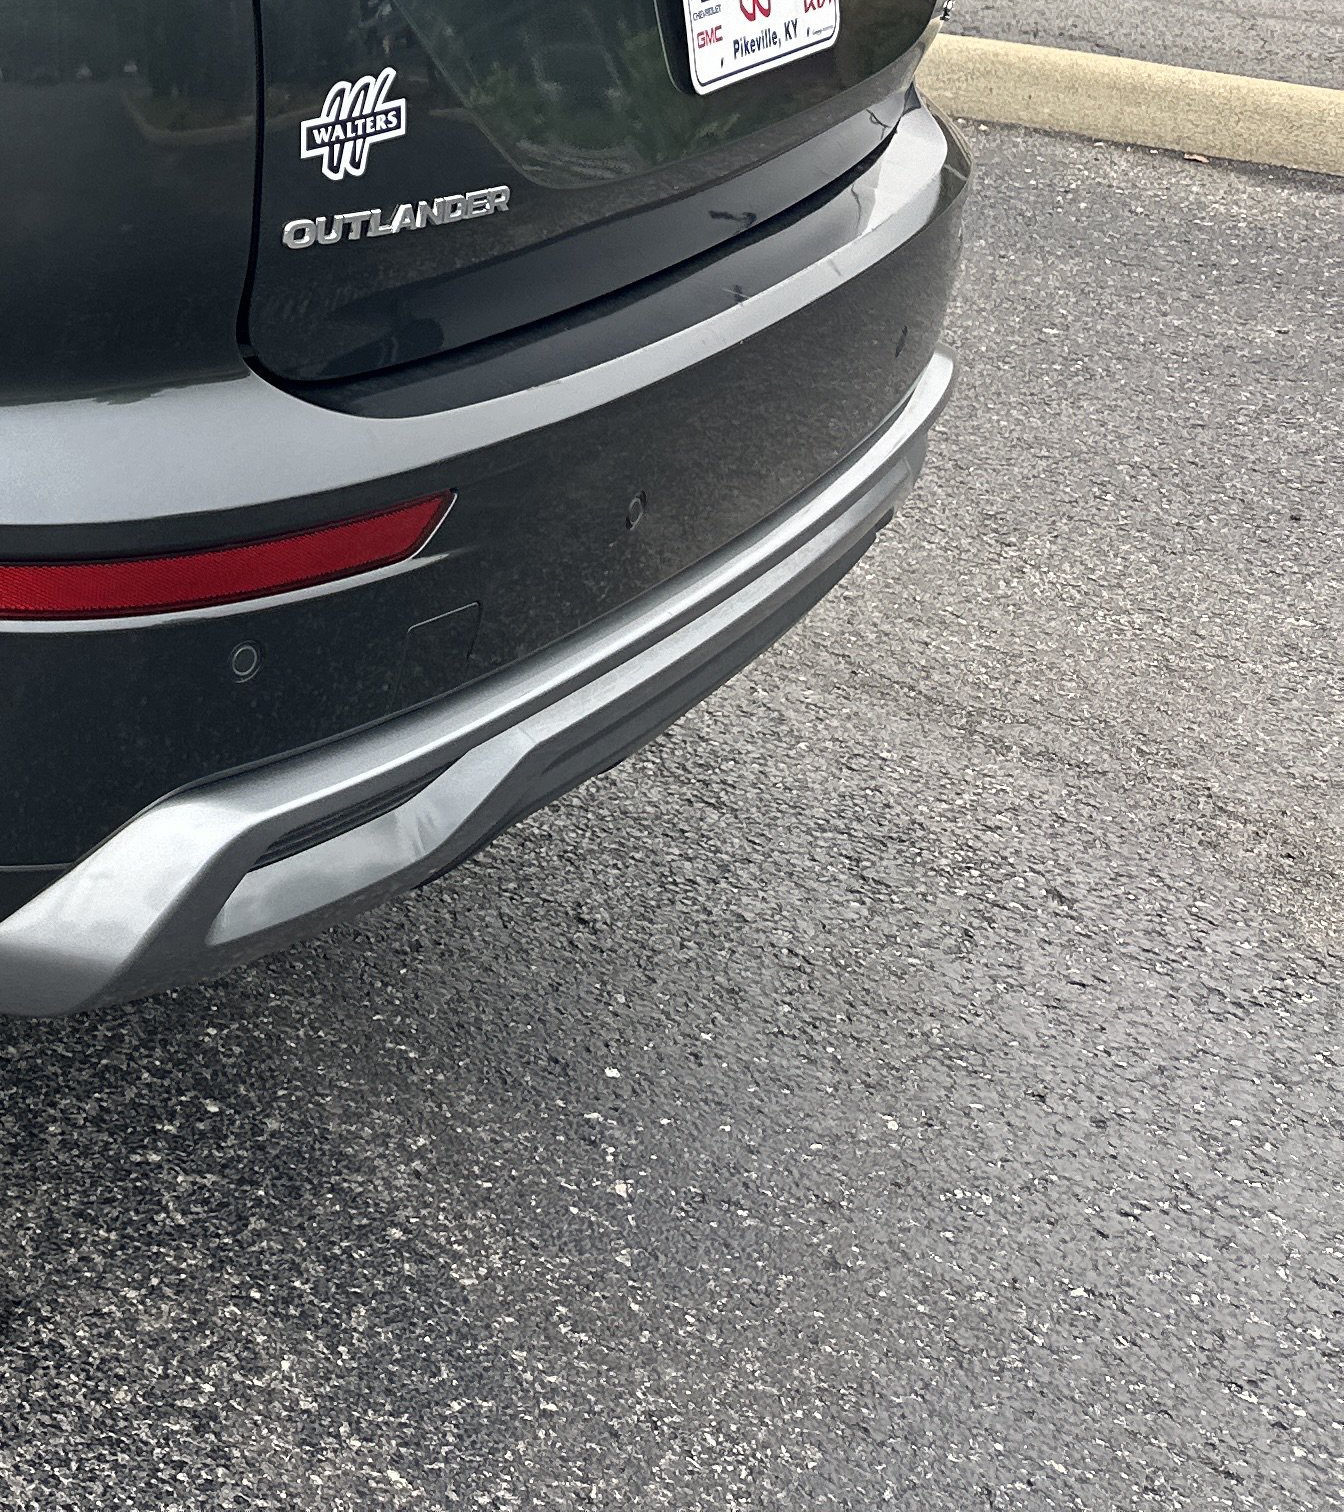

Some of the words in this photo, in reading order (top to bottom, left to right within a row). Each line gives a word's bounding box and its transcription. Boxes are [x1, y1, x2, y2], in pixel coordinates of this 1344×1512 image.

[696, 25, 723, 49] GMC
[732, 28, 782, 60] Pikeville,
[784, 18, 798, 42] KY
[312, 110, 398, 145] WALTERS
[282, 185, 511, 250] OUTLANDER
